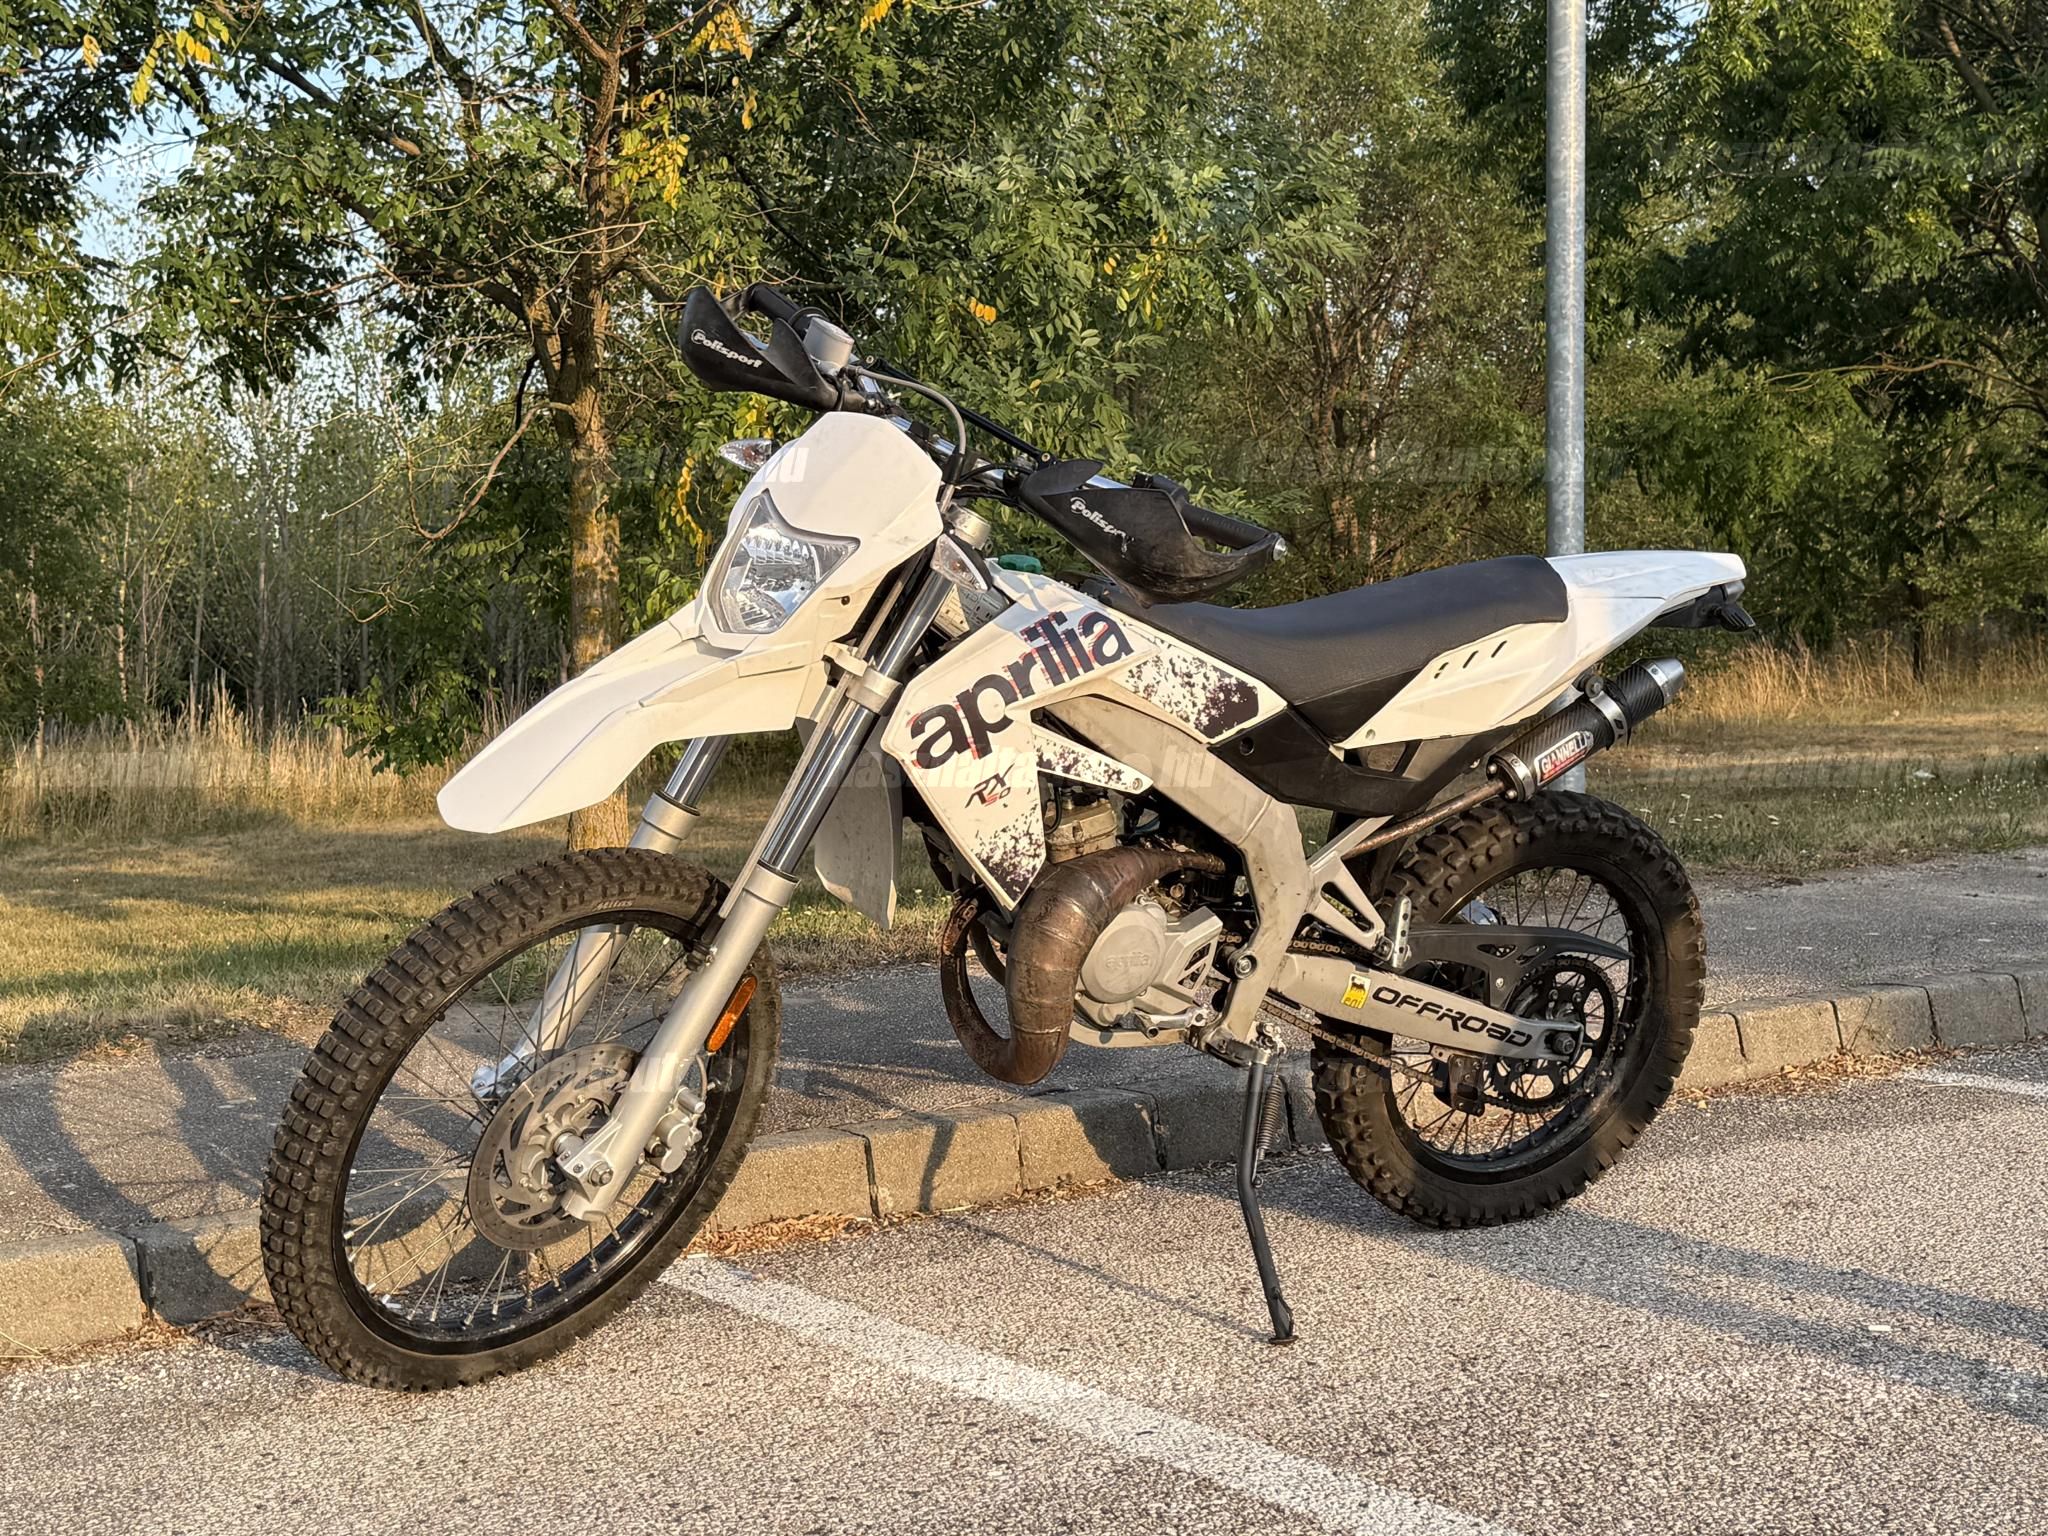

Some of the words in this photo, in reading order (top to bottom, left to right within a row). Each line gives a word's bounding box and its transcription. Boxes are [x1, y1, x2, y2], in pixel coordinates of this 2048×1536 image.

[691, 329, 763, 368] Polisport
[1070, 497, 1130, 543] Polisp
[907, 610, 1134, 769] aprilia
[1344, 996, 1364, 1009] eni
